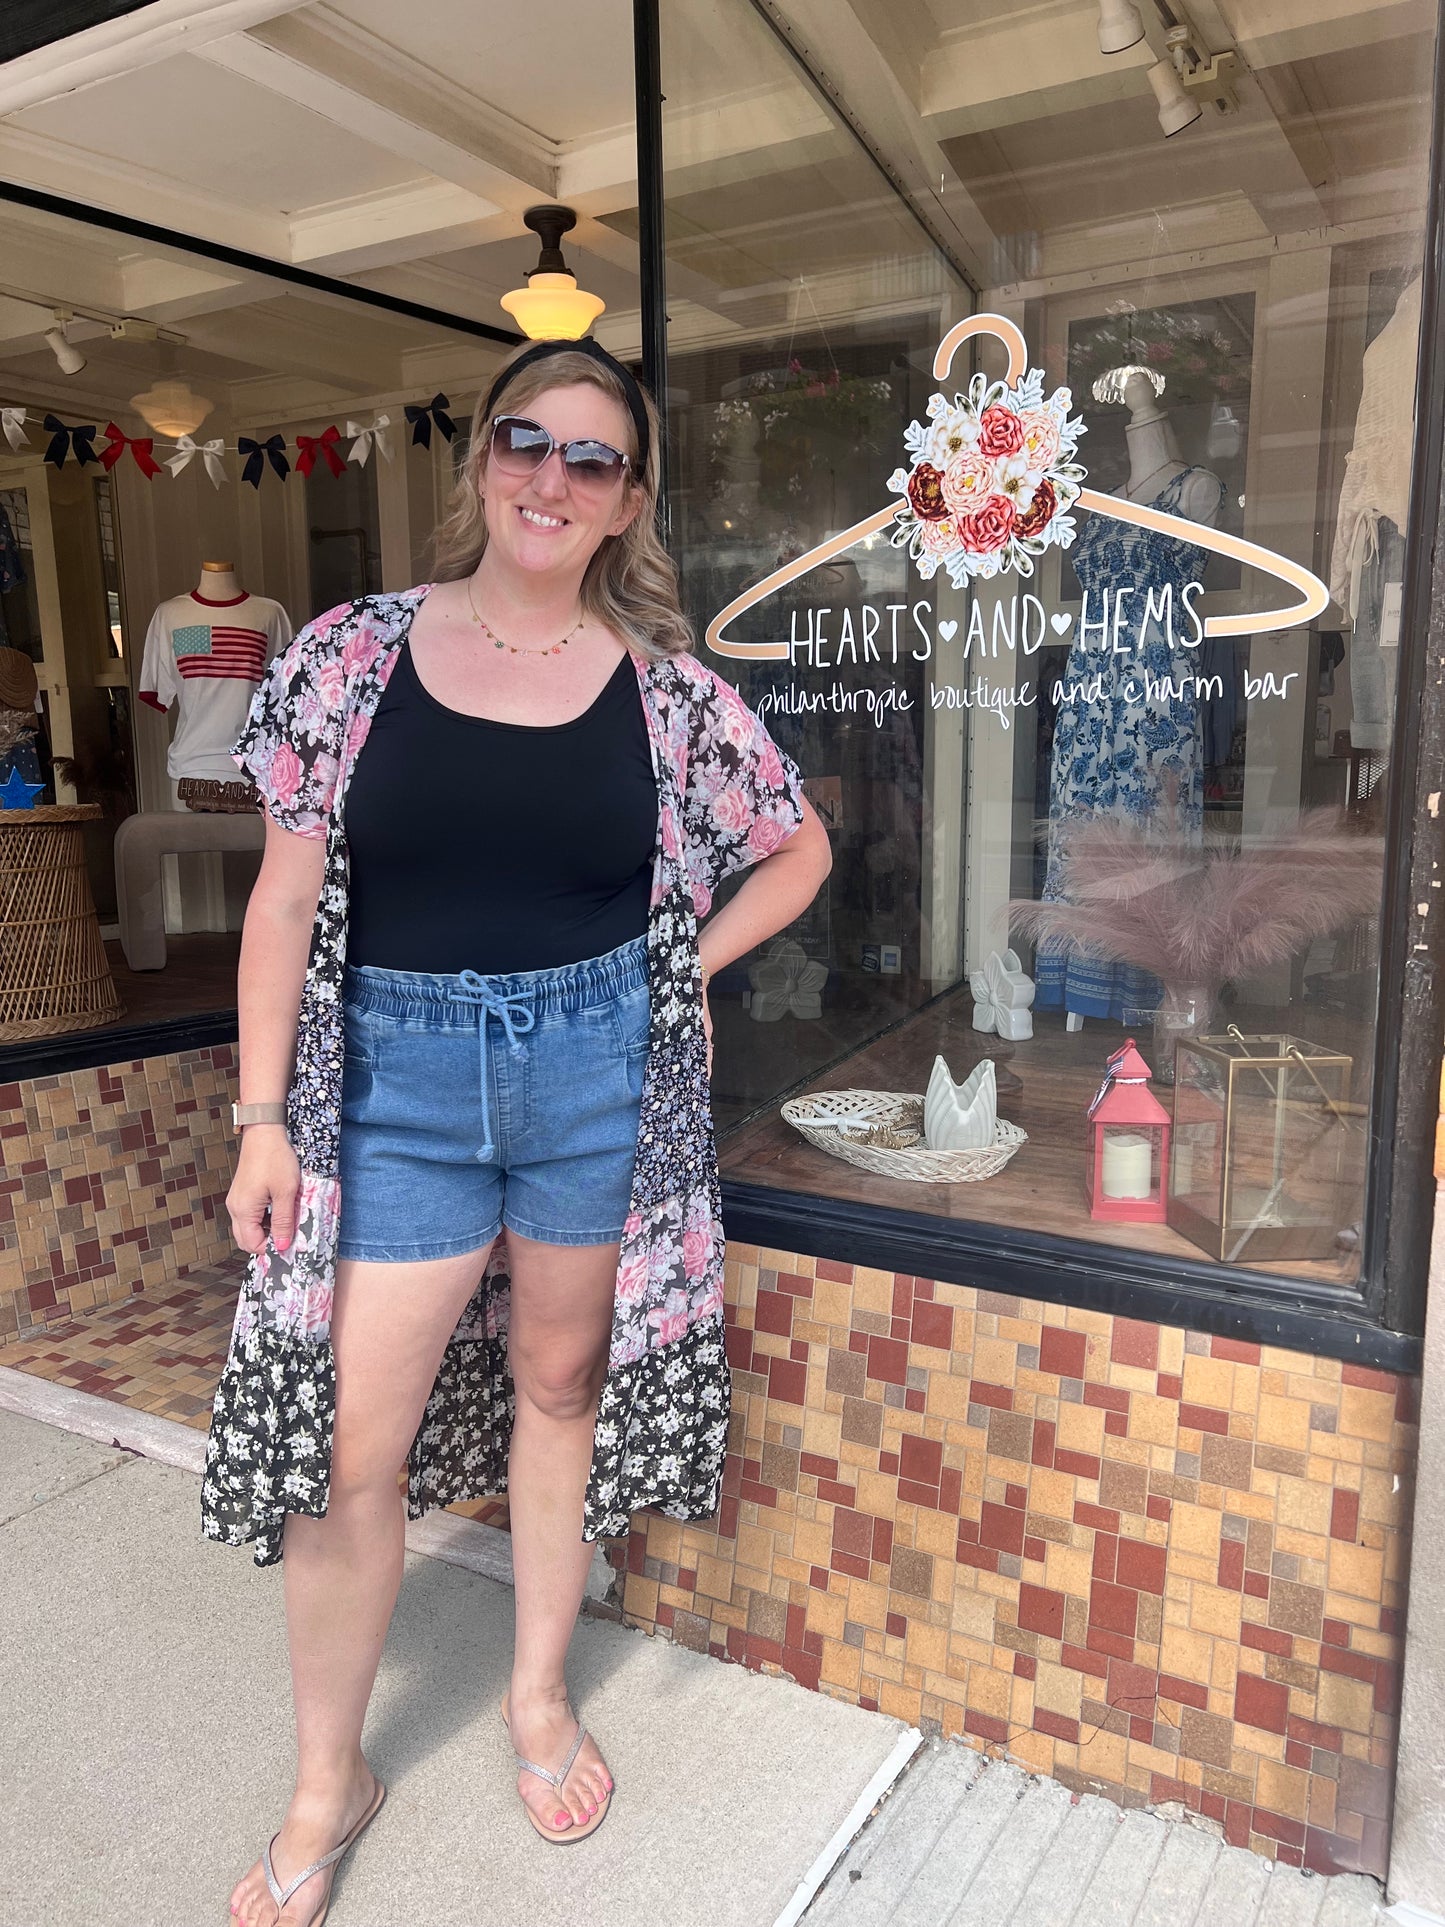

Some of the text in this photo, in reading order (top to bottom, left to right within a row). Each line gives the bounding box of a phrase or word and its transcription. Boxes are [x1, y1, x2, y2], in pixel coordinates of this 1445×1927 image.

[790, 581, 1205, 668] HEARTS AND HEMS
[757, 669, 1299, 730] philanthropic boutique and charm bar
[181, 779, 218, 798] HEARTS
[224, 783, 245, 800] AND
